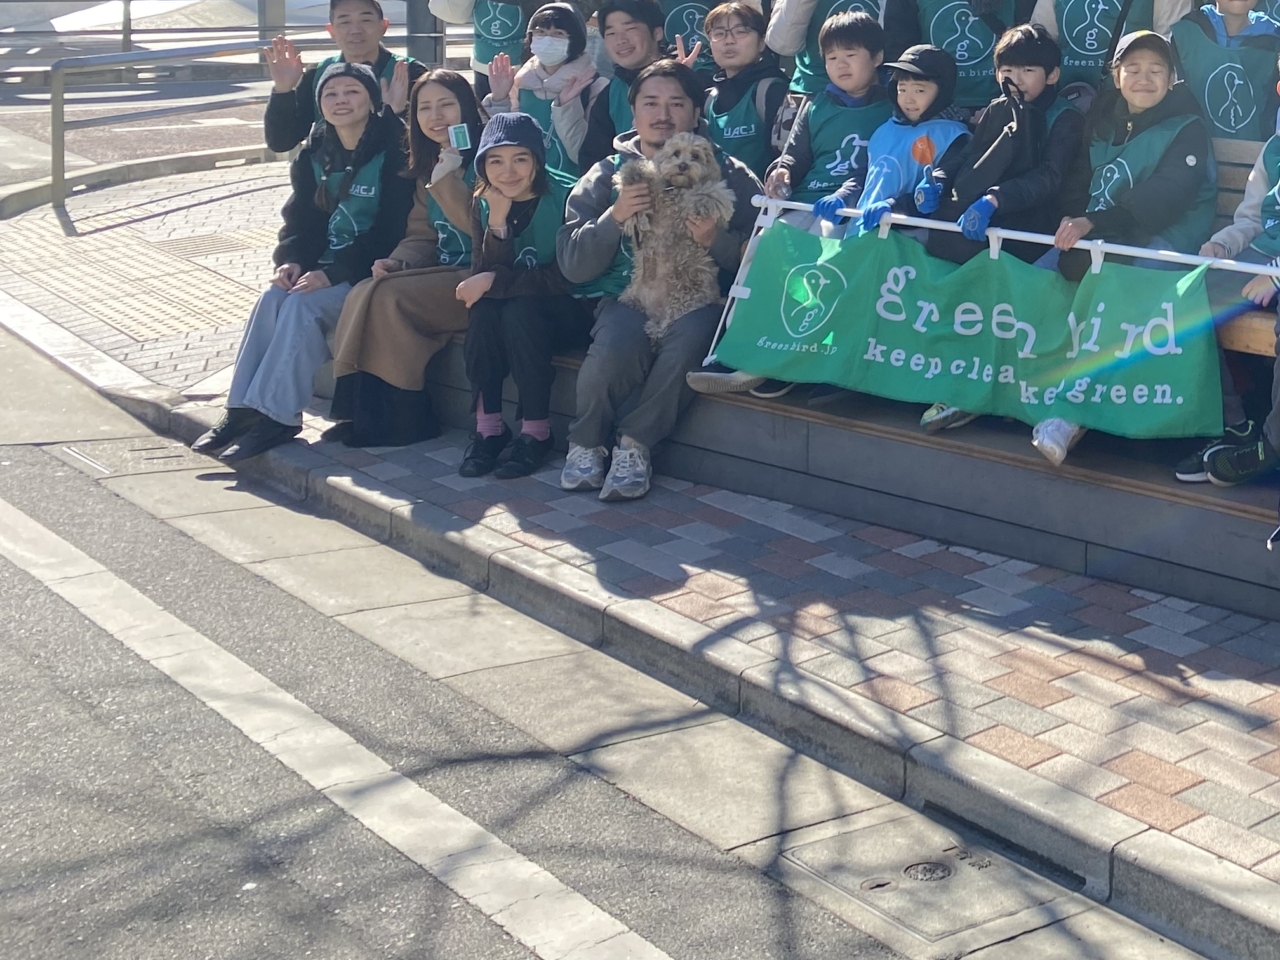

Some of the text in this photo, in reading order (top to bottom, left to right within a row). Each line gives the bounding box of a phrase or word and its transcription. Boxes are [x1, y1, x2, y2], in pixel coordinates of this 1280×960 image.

[1063, 56, 1095, 66] green
[969, 68, 996, 77] bird
[723, 124, 755, 138] UACJ
[875, 265, 1037, 359] green
[756, 336, 838, 355] greenbird.jp
[863, 338, 943, 380] keep
[950, 356, 1016, 384] clea
[1065, 376, 1184, 405] green.
